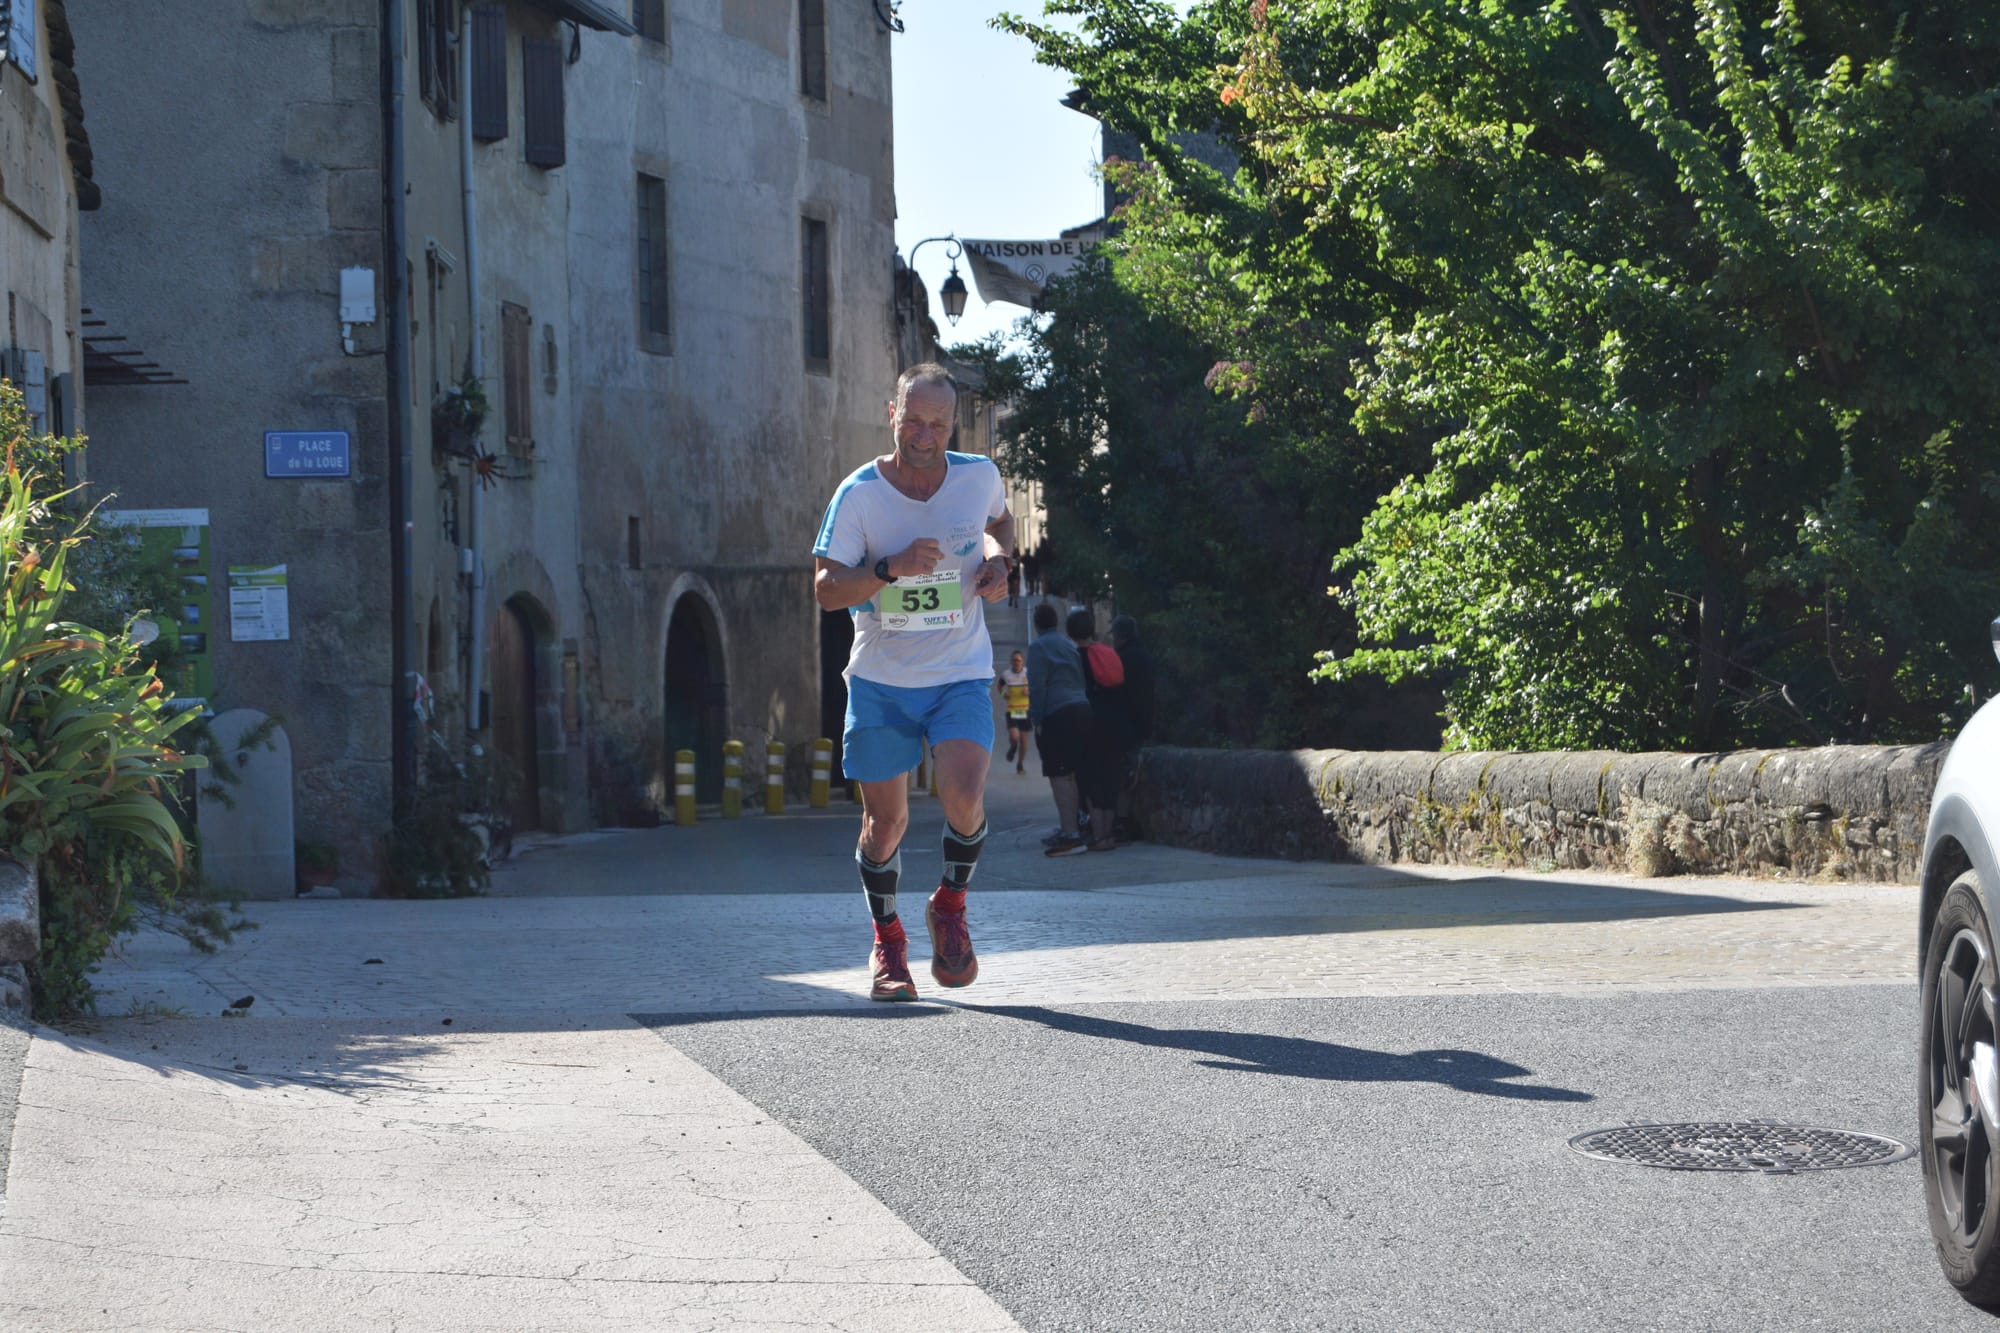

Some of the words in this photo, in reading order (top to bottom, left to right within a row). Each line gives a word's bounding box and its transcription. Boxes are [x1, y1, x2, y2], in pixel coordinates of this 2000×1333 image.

[966, 241, 1043, 257] MAISON
[1049, 241, 1073, 256] DE
[298, 439, 333, 452] PLACE
[287, 456, 301, 469] de
[303, 456, 313, 469] la
[316, 456, 344, 469] LOUE
[902, 587, 940, 612] 53
